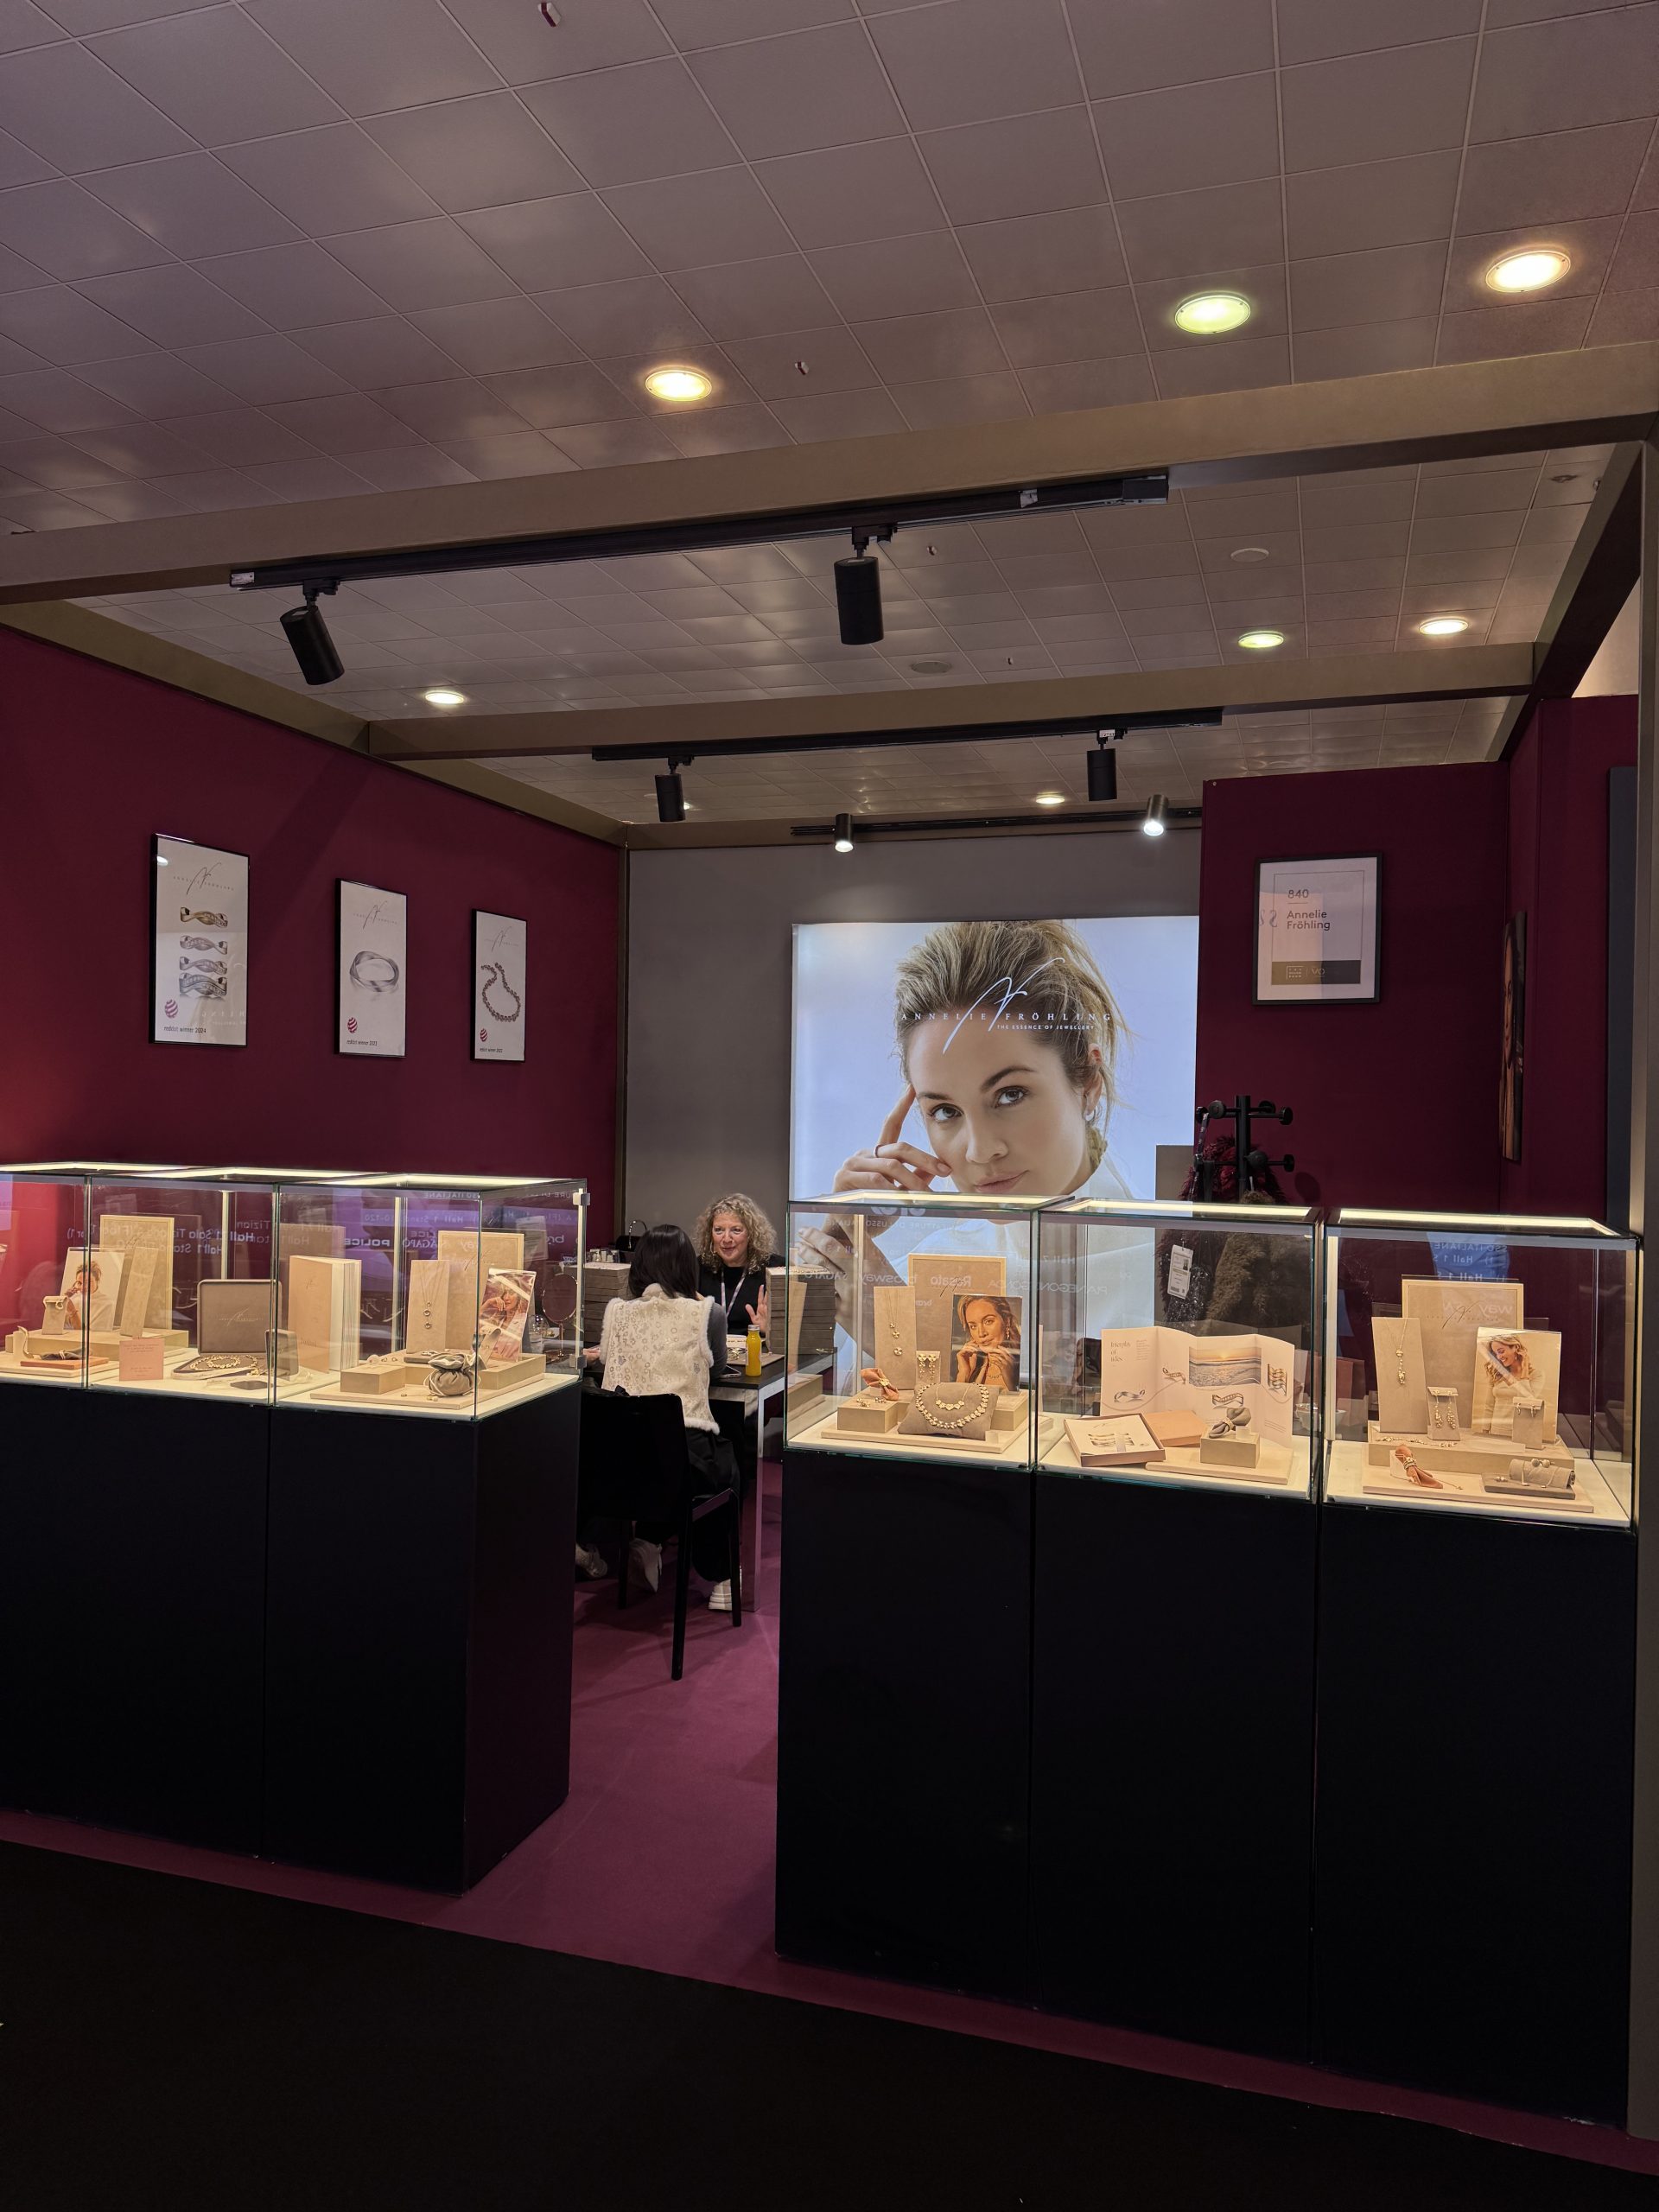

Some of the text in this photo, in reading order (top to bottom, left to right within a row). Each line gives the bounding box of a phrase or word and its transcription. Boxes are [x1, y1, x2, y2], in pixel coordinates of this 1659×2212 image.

[1287, 889, 1309, 899] 840
[1287, 910, 1327, 918] Annelie
[1287, 920, 1331, 931] Fröhling
[1005, 1012, 1111, 1020] FRÖHLING
